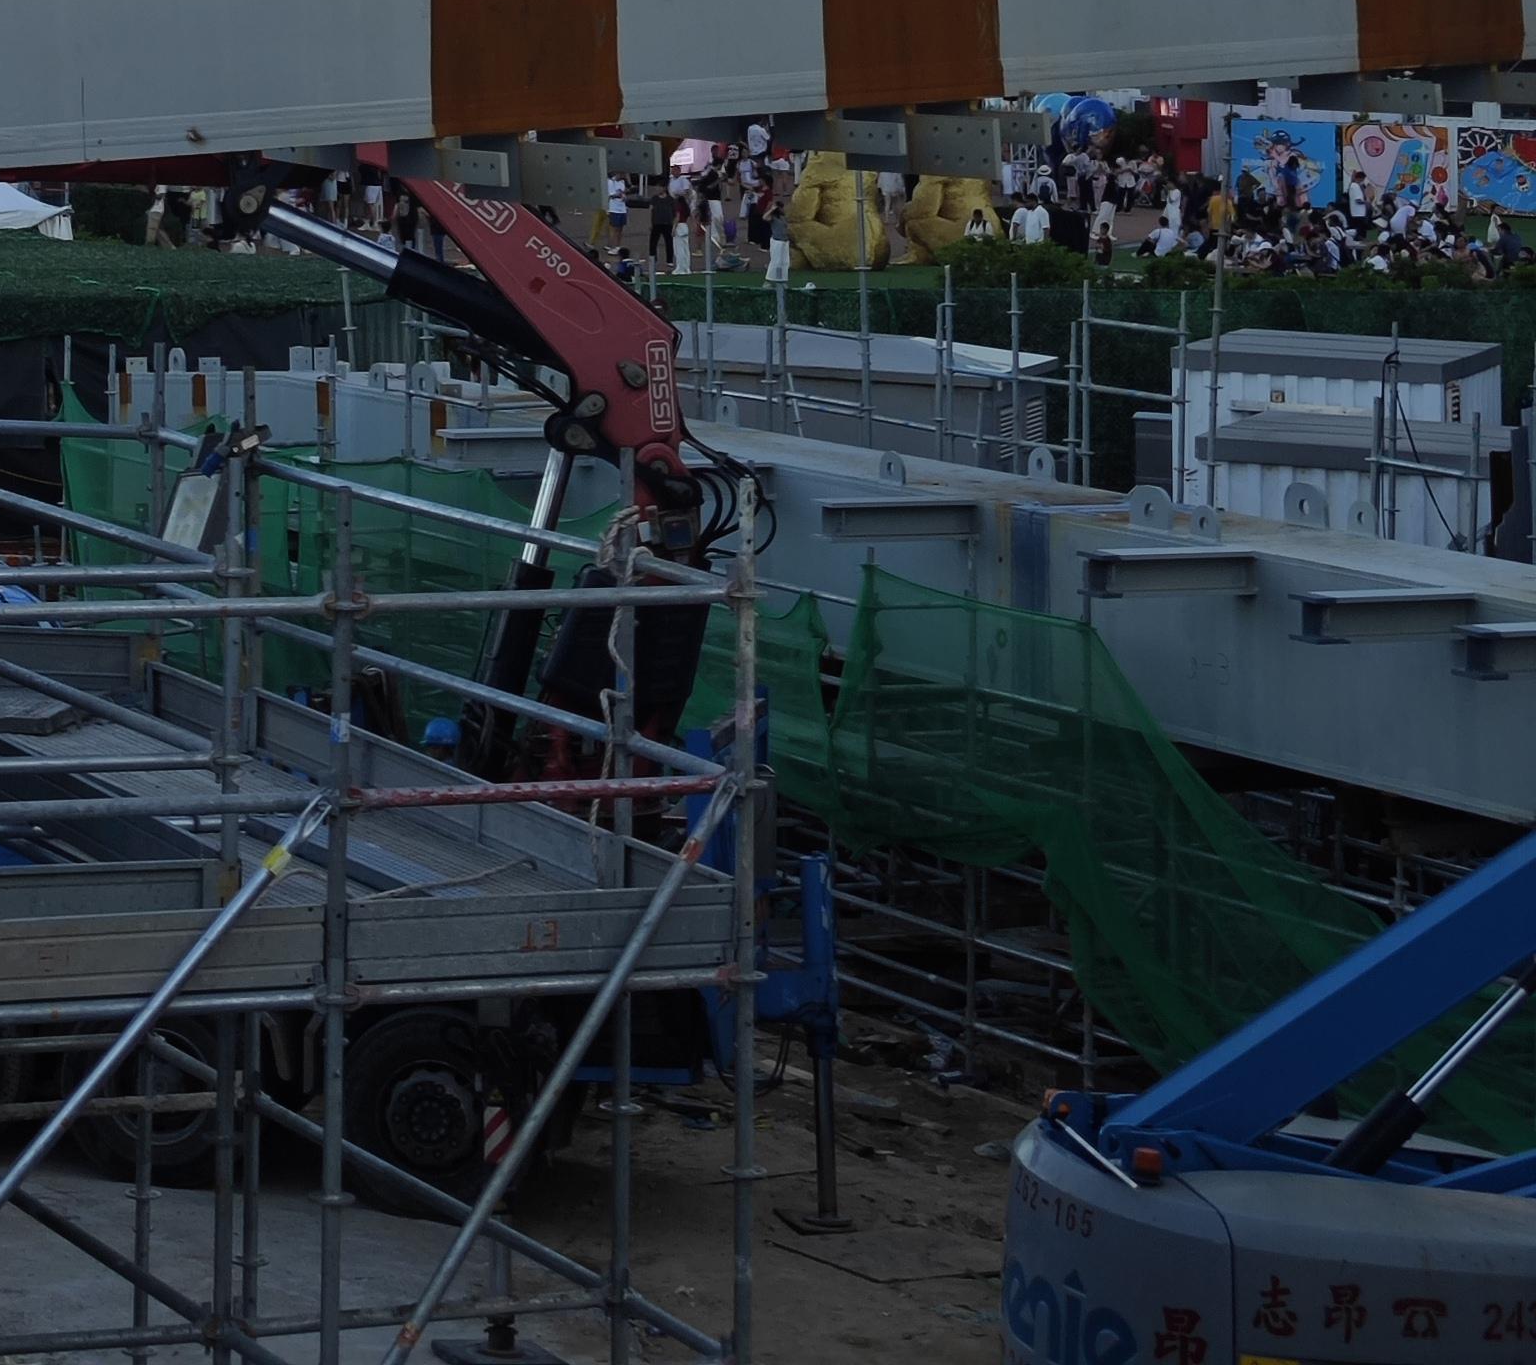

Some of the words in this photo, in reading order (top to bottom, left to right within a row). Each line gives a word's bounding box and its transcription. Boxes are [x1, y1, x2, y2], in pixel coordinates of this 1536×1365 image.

[524, 236, 571, 278] F950
[650, 347, 672, 427] FASSI
[1004, 1255, 1138, 1365] enie
